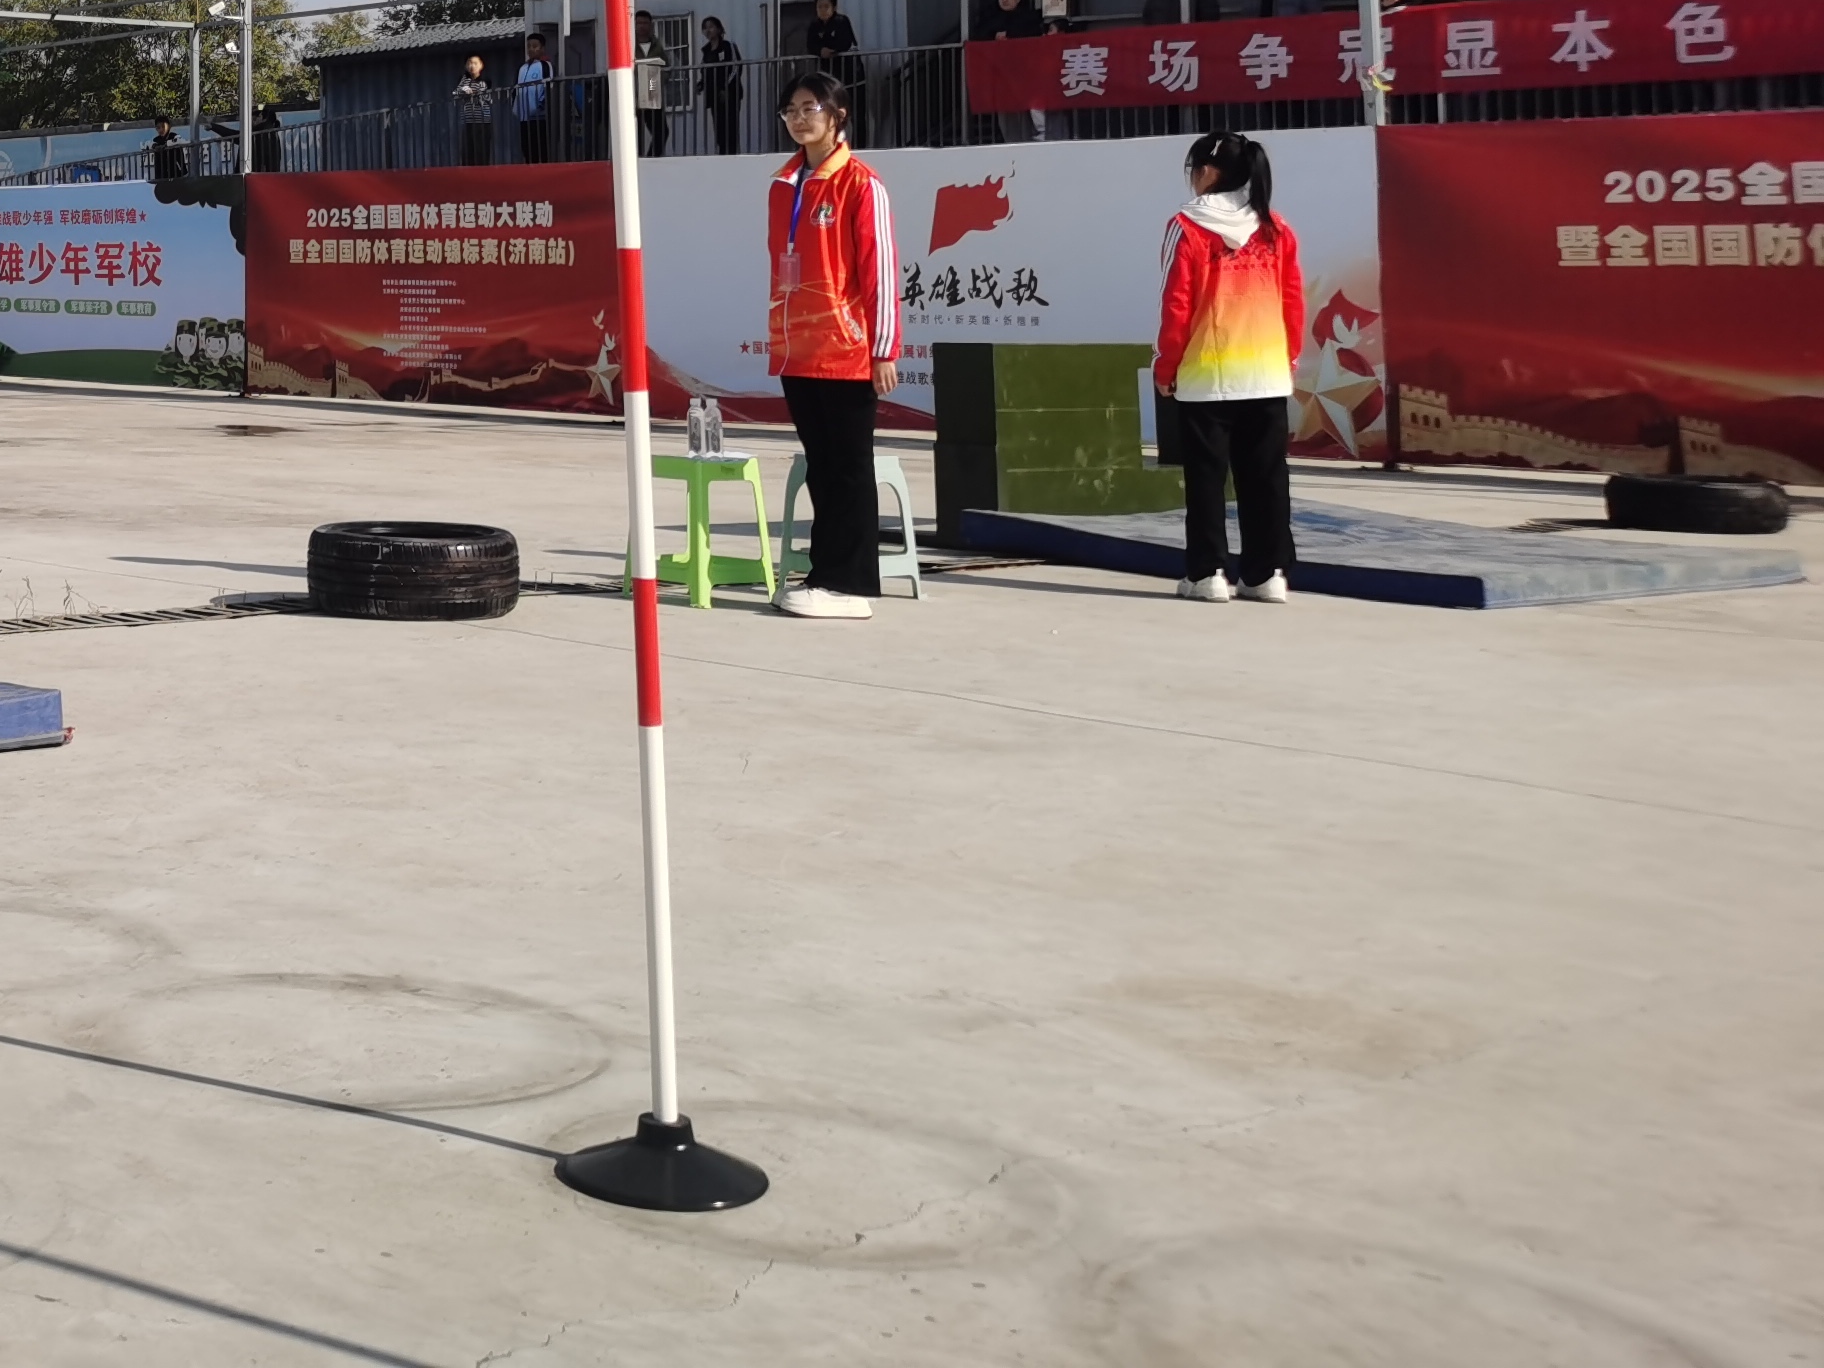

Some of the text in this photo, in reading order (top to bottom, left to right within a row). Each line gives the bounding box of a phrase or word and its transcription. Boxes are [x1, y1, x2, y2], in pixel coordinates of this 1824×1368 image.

[306, 201, 554, 230] 2025全国国防体育运动大联动
[899, 262, 1049, 310] 英雄战歌
